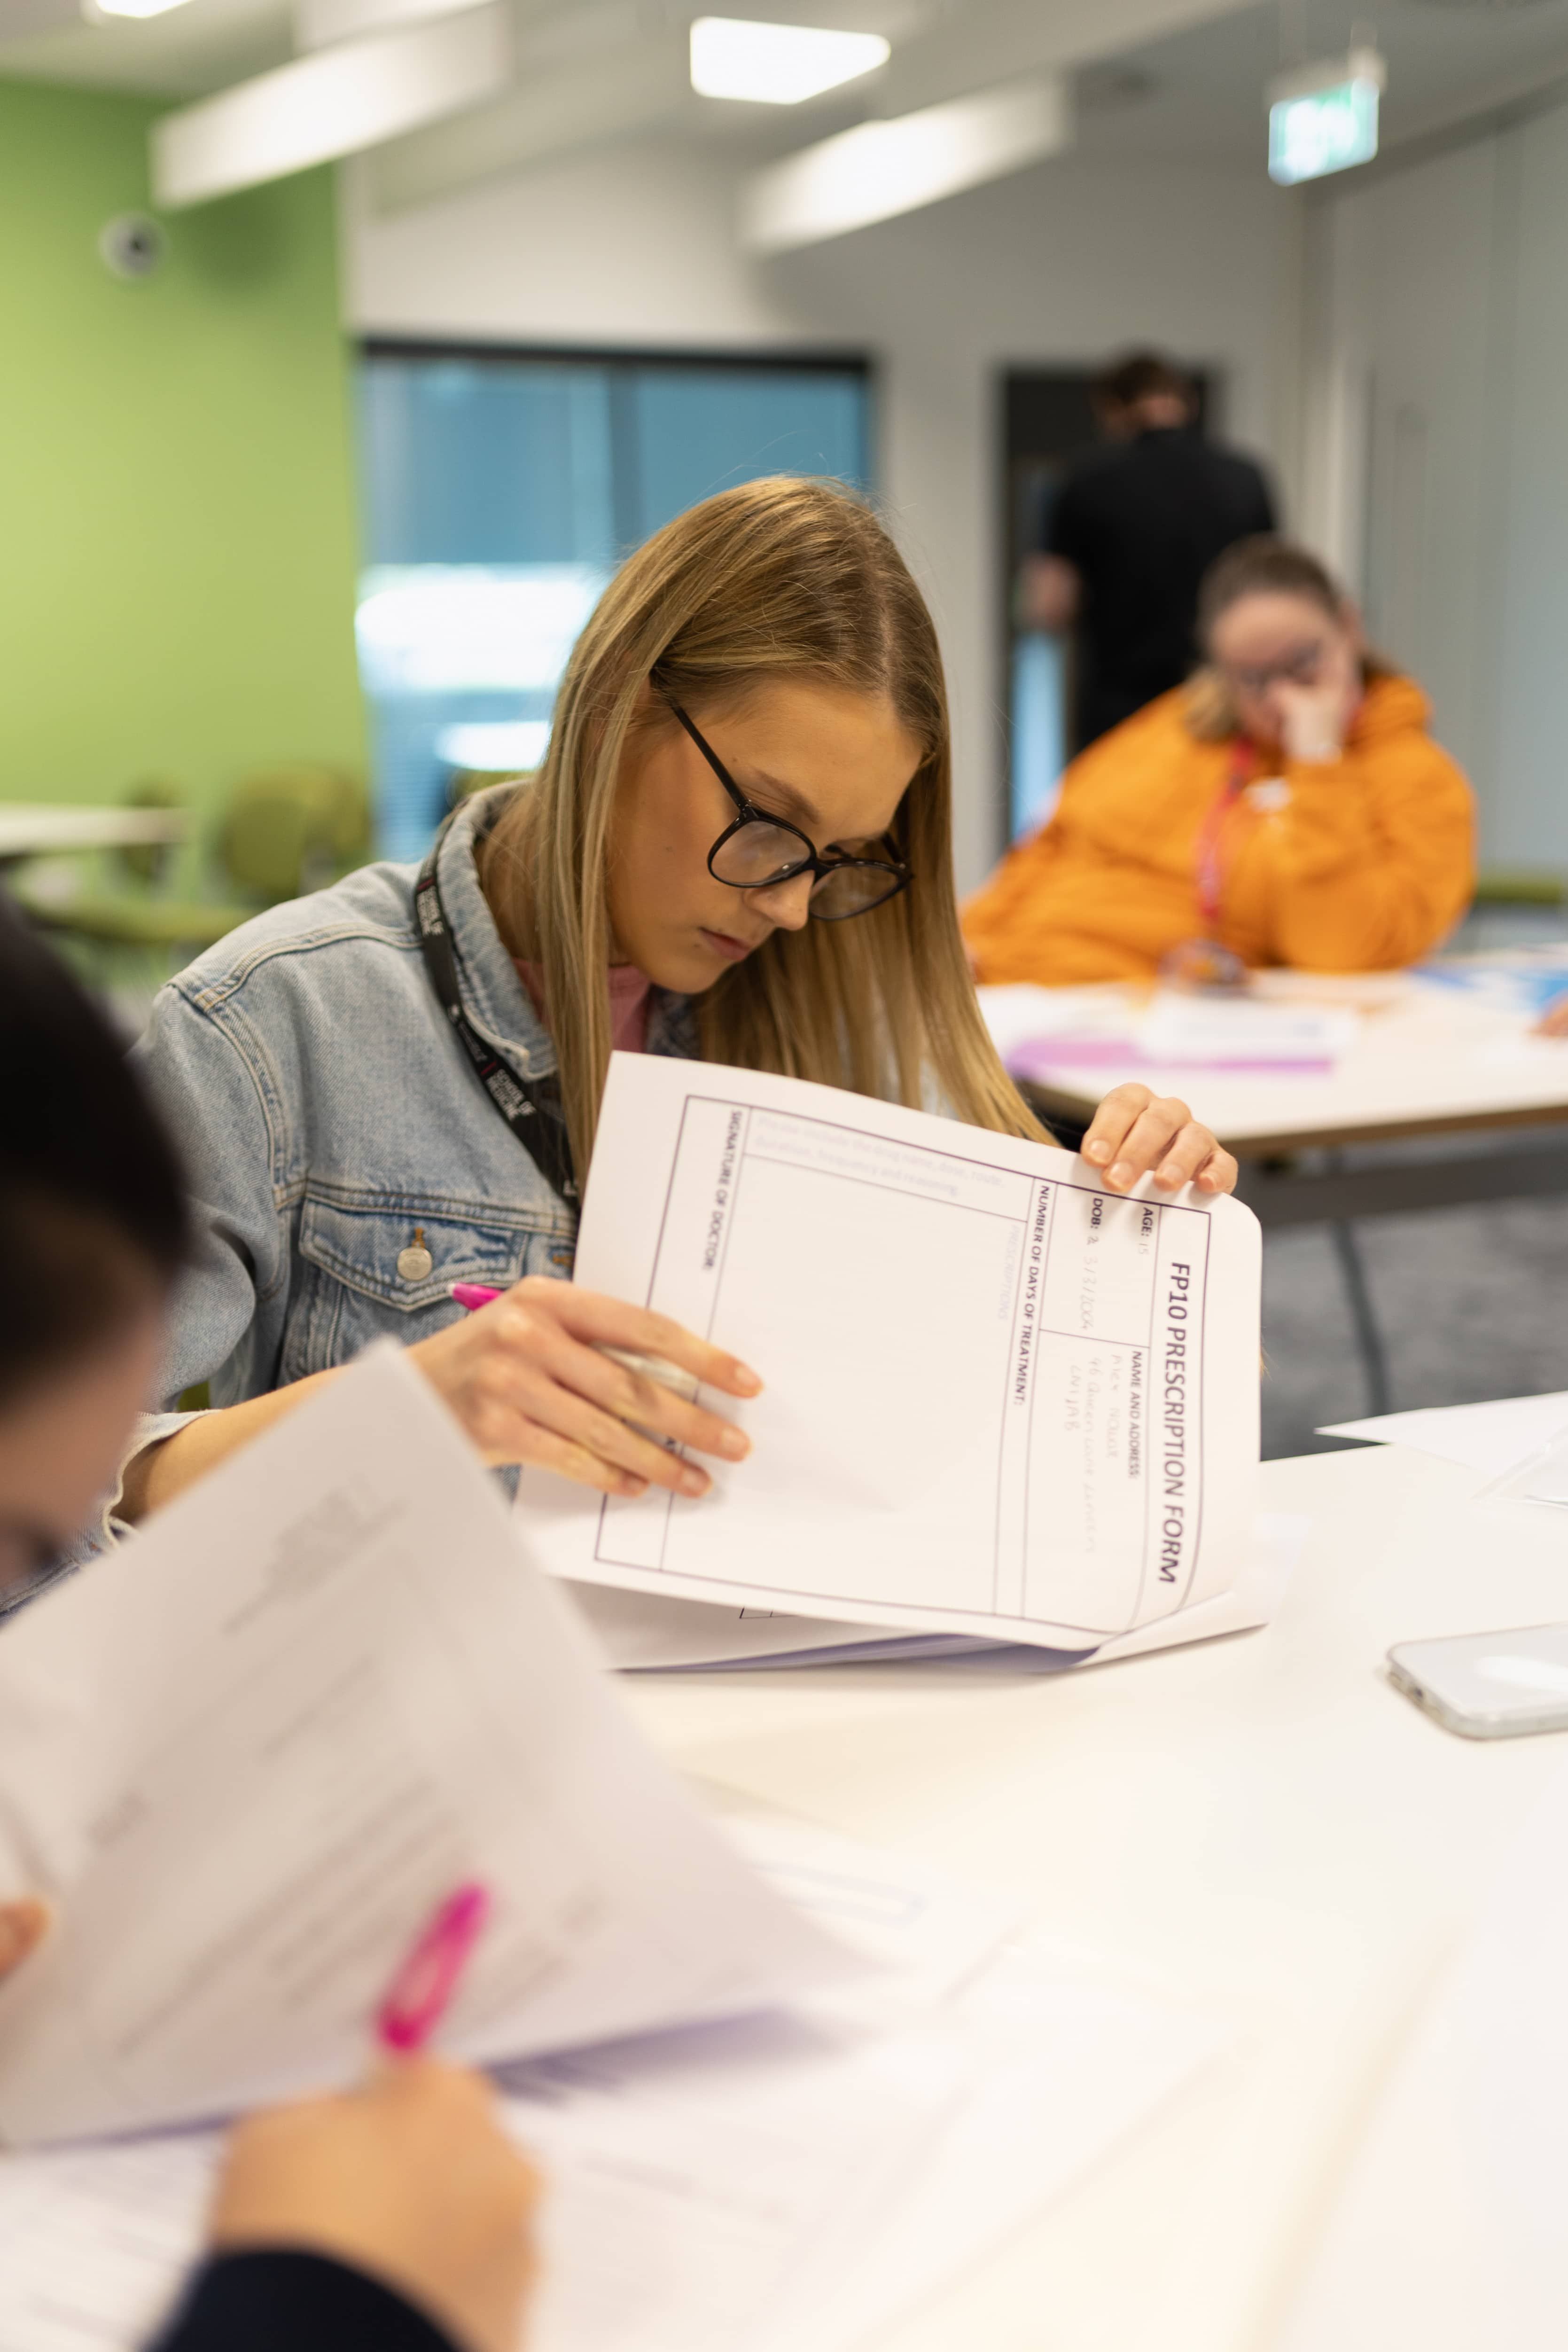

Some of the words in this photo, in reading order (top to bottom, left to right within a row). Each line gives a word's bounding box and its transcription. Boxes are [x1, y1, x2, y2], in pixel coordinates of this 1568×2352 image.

[486, 1076, 519, 1121] MEDICINE
[493, 1069, 525, 1105] SCHOOL
[518, 1101, 537, 1117] OF
[717, 1111, 742, 1186] SIGNATURE
[715, 1189, 728, 1207] OF
[1033, 1185, 1050, 1242] NUMBER
[1089, 1197, 1103, 1230] DOB:
[1140, 1206, 1154, 1237] AGE:
[996, 1224, 1021, 1322] PRESCRIPTIONS
[1030, 1245, 1041, 1263] OF
[1025, 1266, 1039, 1300] DAYS
[1167, 1262, 1190, 1320] FP10
[1023, 1303, 1034, 1319] OF
[1013, 1324, 1032, 1407] TREATMENT:
[1130, 1351, 1142, 1388] NAME
[1129, 1391, 1140, 1419] AND
[1163, 1326, 1186, 1496] PRESCRIPTION
[1128, 1422, 1139, 1480] ADDRESS:
[1157, 1504, 1184, 1584] FORM
